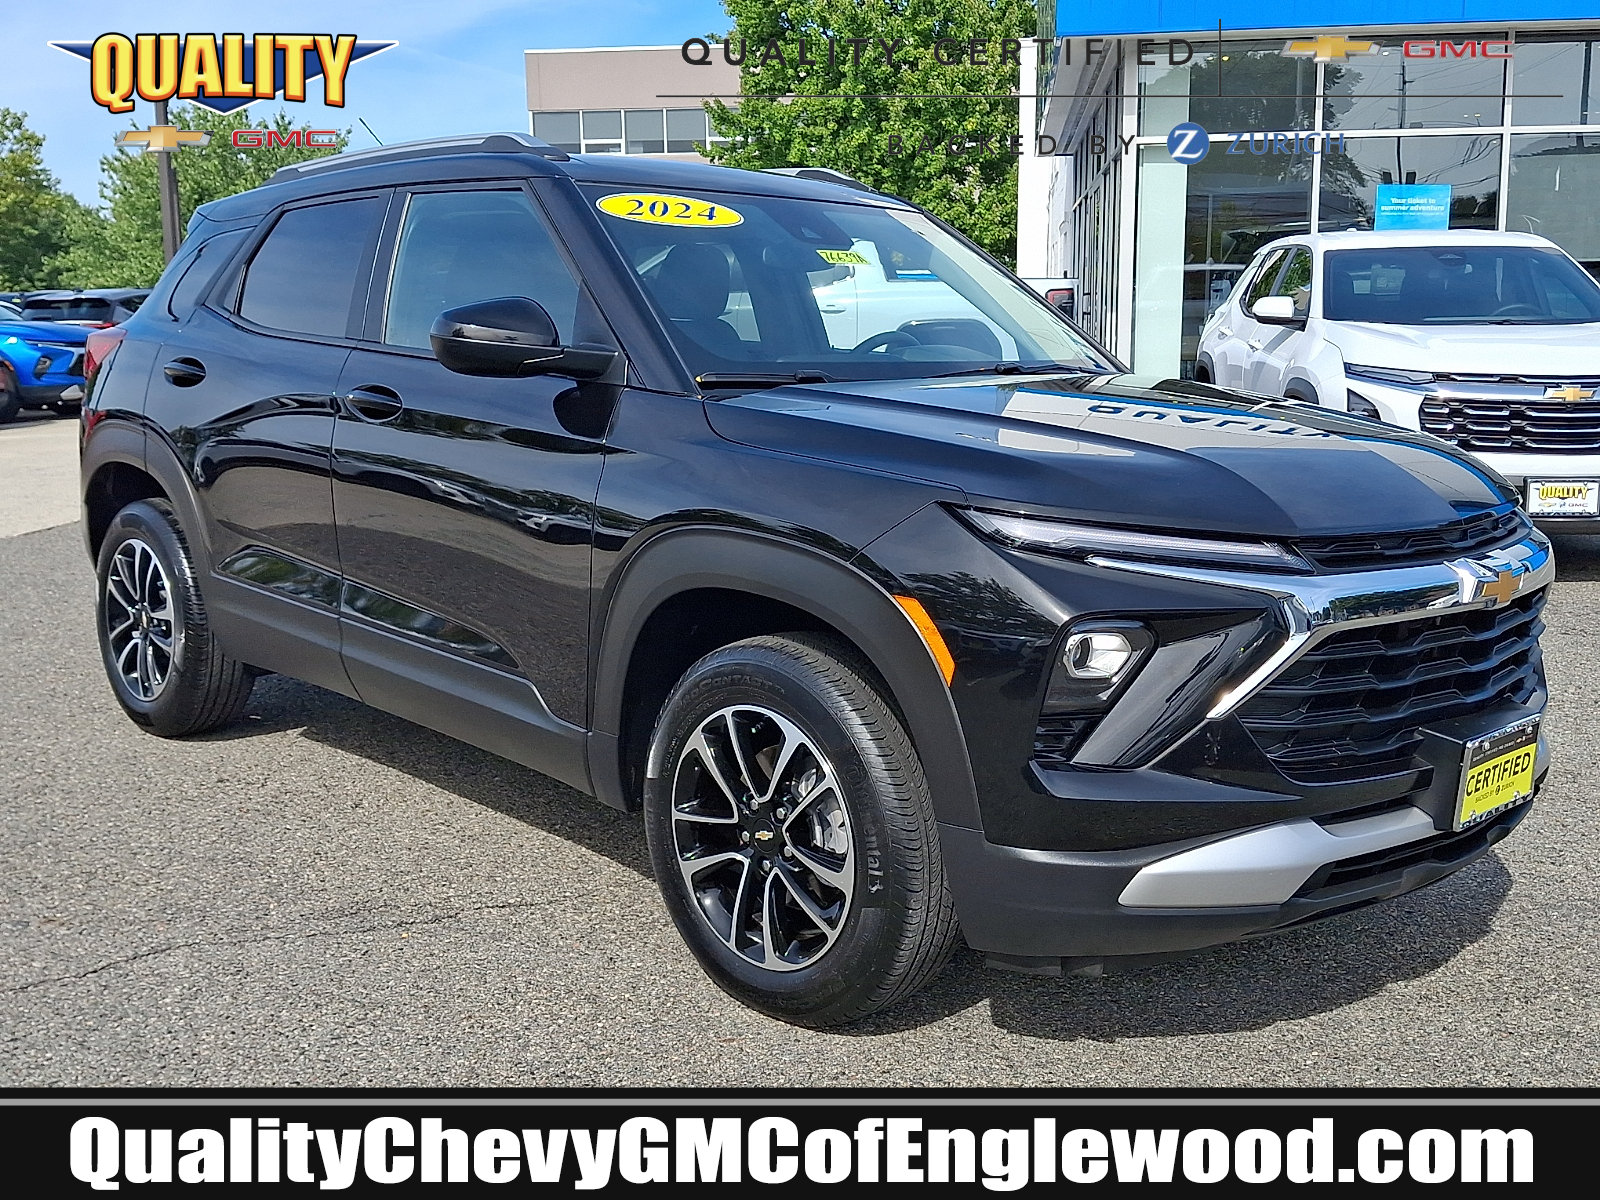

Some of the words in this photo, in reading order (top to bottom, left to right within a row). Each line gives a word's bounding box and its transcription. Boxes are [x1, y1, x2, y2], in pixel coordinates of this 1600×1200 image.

[626, 199, 717, 221] 2024
[1539, 486, 1588, 500] QUALITY
[1466, 752, 1531, 797] CERTIFIED
